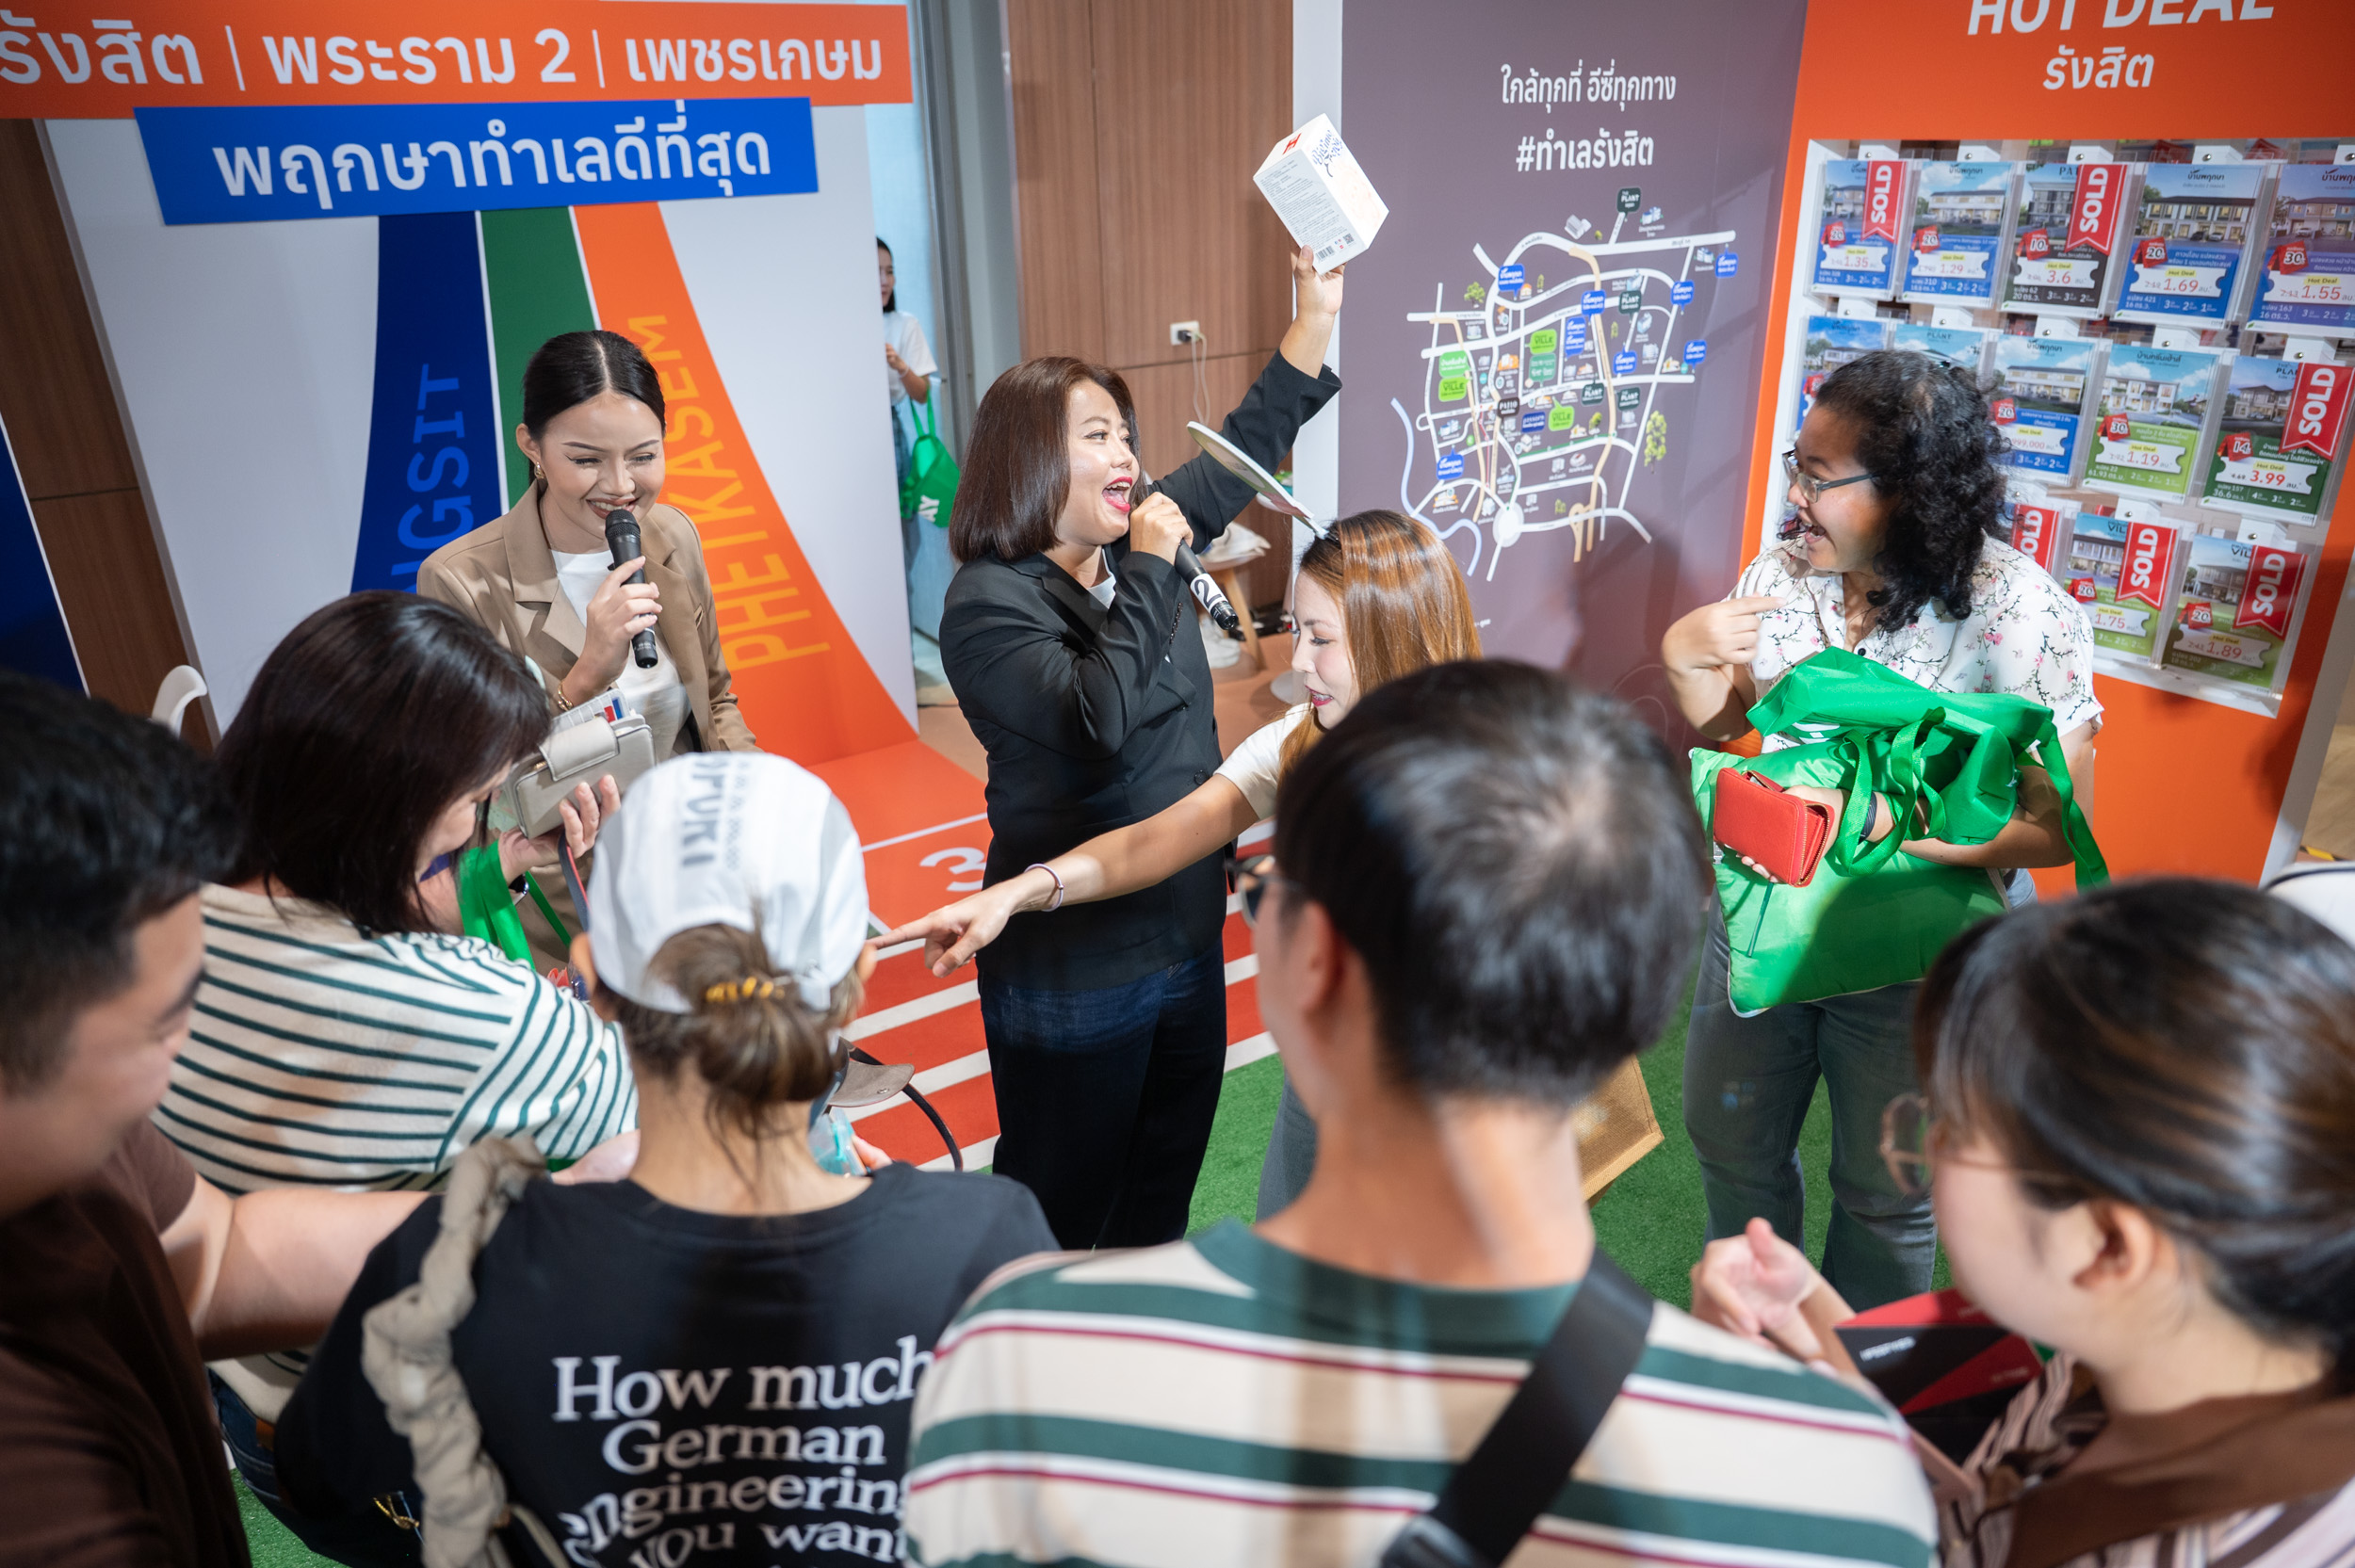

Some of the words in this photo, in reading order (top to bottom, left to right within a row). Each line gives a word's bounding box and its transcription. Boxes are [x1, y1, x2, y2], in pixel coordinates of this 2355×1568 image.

[0, 9, 203, 85] รังสิต
[262, 36, 516, 85] พระราม
[534, 28, 577, 83] 2
[625, 38, 882, 83] เพชรเกษม
[2042, 44, 2155, 90] รังสิต
[1501, 58, 1584, 114] ใกล้ทุกที่
[1587, 57, 1677, 112] อีซี่ทุกทาง
[212, 99, 771, 211] พฤกษาทำเลดีที่สุด
[1516, 127, 1655, 172] #ทำเลรังสิต
[1871, 165, 1892, 224] SOLD
[2079, 167, 2108, 234] SOLD
[1940, 263, 1964, 274] 1.29
[2047, 270, 2071, 284] 3.6
[2164, 279, 2199, 292] 1.69
[2301, 285, 2342, 300] 1.55
[1926, 331, 1952, 340] PLANT
[2298, 368, 2336, 437] SOLD
[391, 364, 474, 596] GSIT
[2127, 451, 2160, 466] 1.19
[2249, 470, 2286, 486] 3.99
[2020, 509, 2042, 562] OLD
[2131, 528, 2158, 589] SOLD
[1194, 578, 1223, 609] 2
[2252, 554, 2286, 617] SOLD
[2095, 614, 2126, 629] 1.75
[2207, 642, 2242, 658] 1.89
[551, 1354, 731, 1422] How
[747, 1334, 935, 1411] much
[602, 1419, 886, 1475] German
